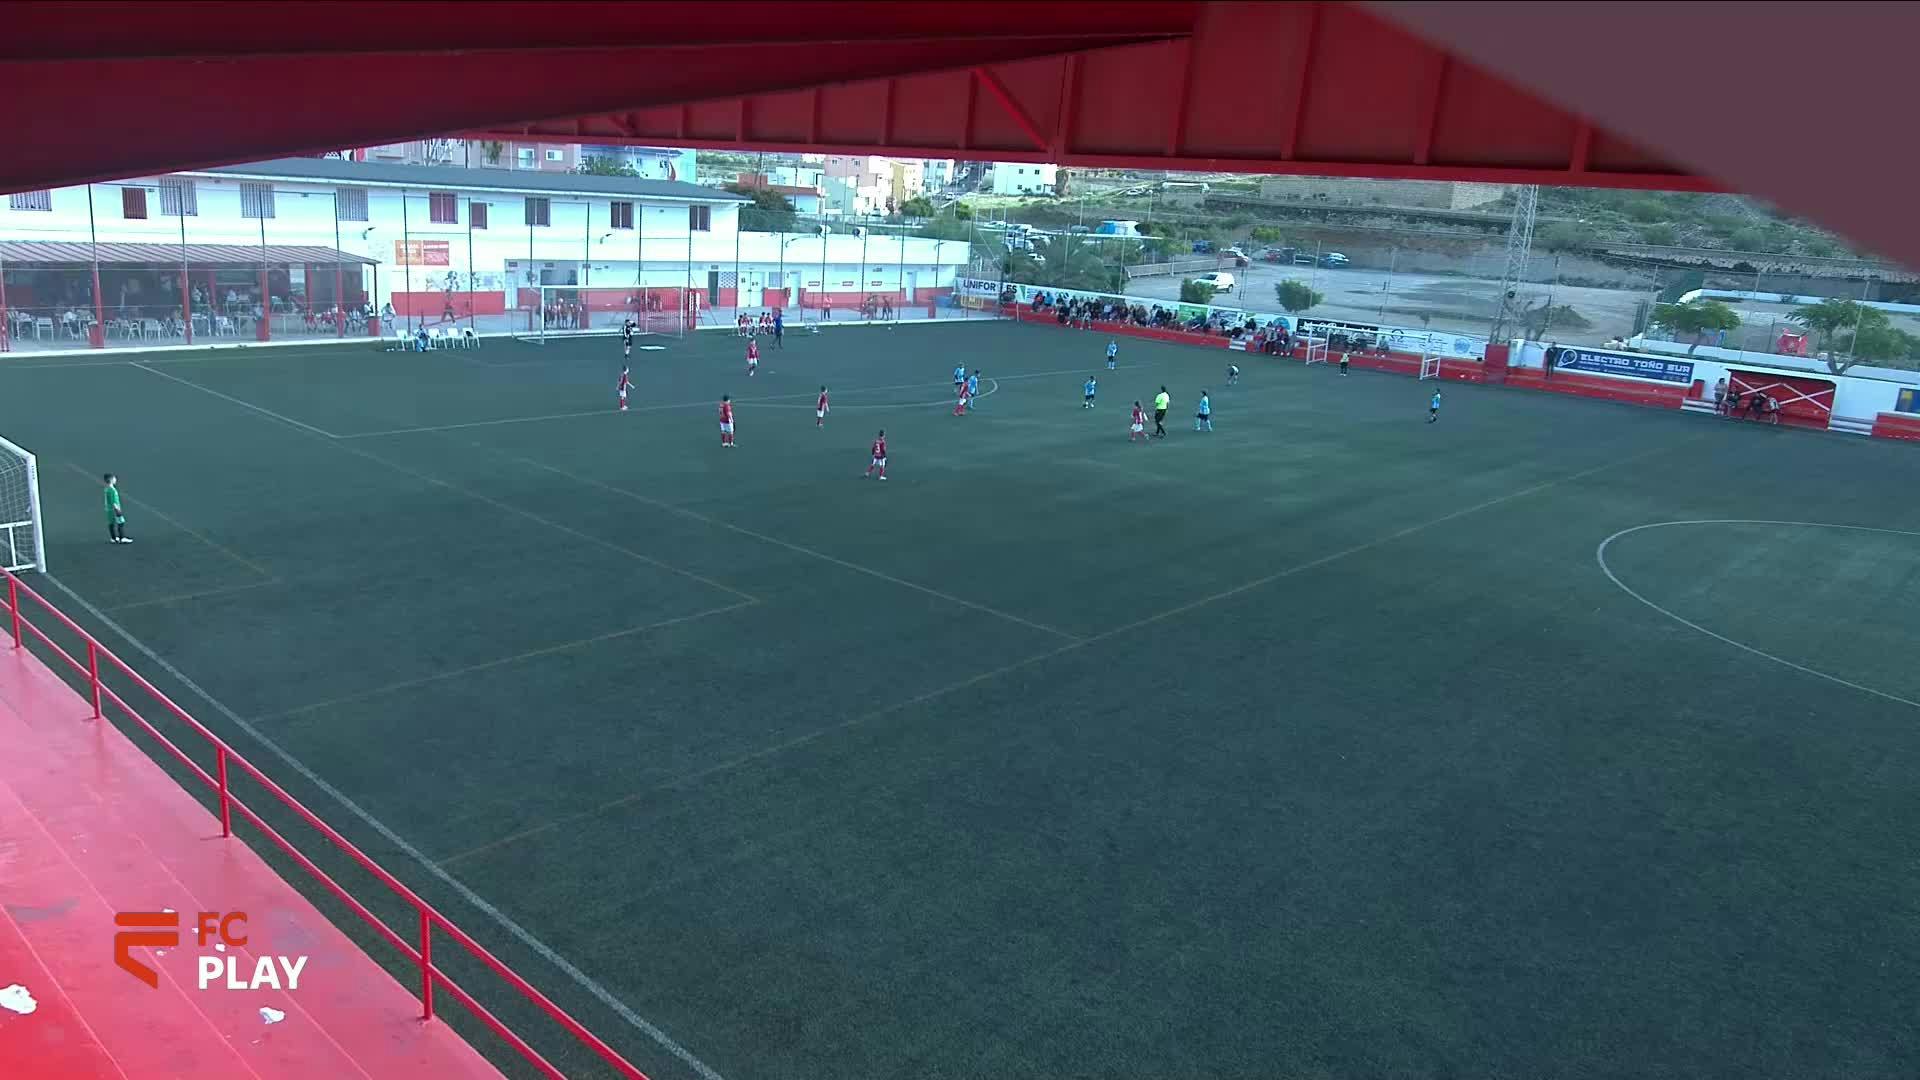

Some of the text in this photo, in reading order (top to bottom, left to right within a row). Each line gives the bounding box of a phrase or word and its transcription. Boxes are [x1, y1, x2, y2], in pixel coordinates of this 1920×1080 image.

[963, 280, 1018, 294] UNIFORES
[1580, 354, 1630, 366] ELECTRO
[1633, 359, 1664, 370] TOÑO
[1667, 364, 1690, 373] SUR
